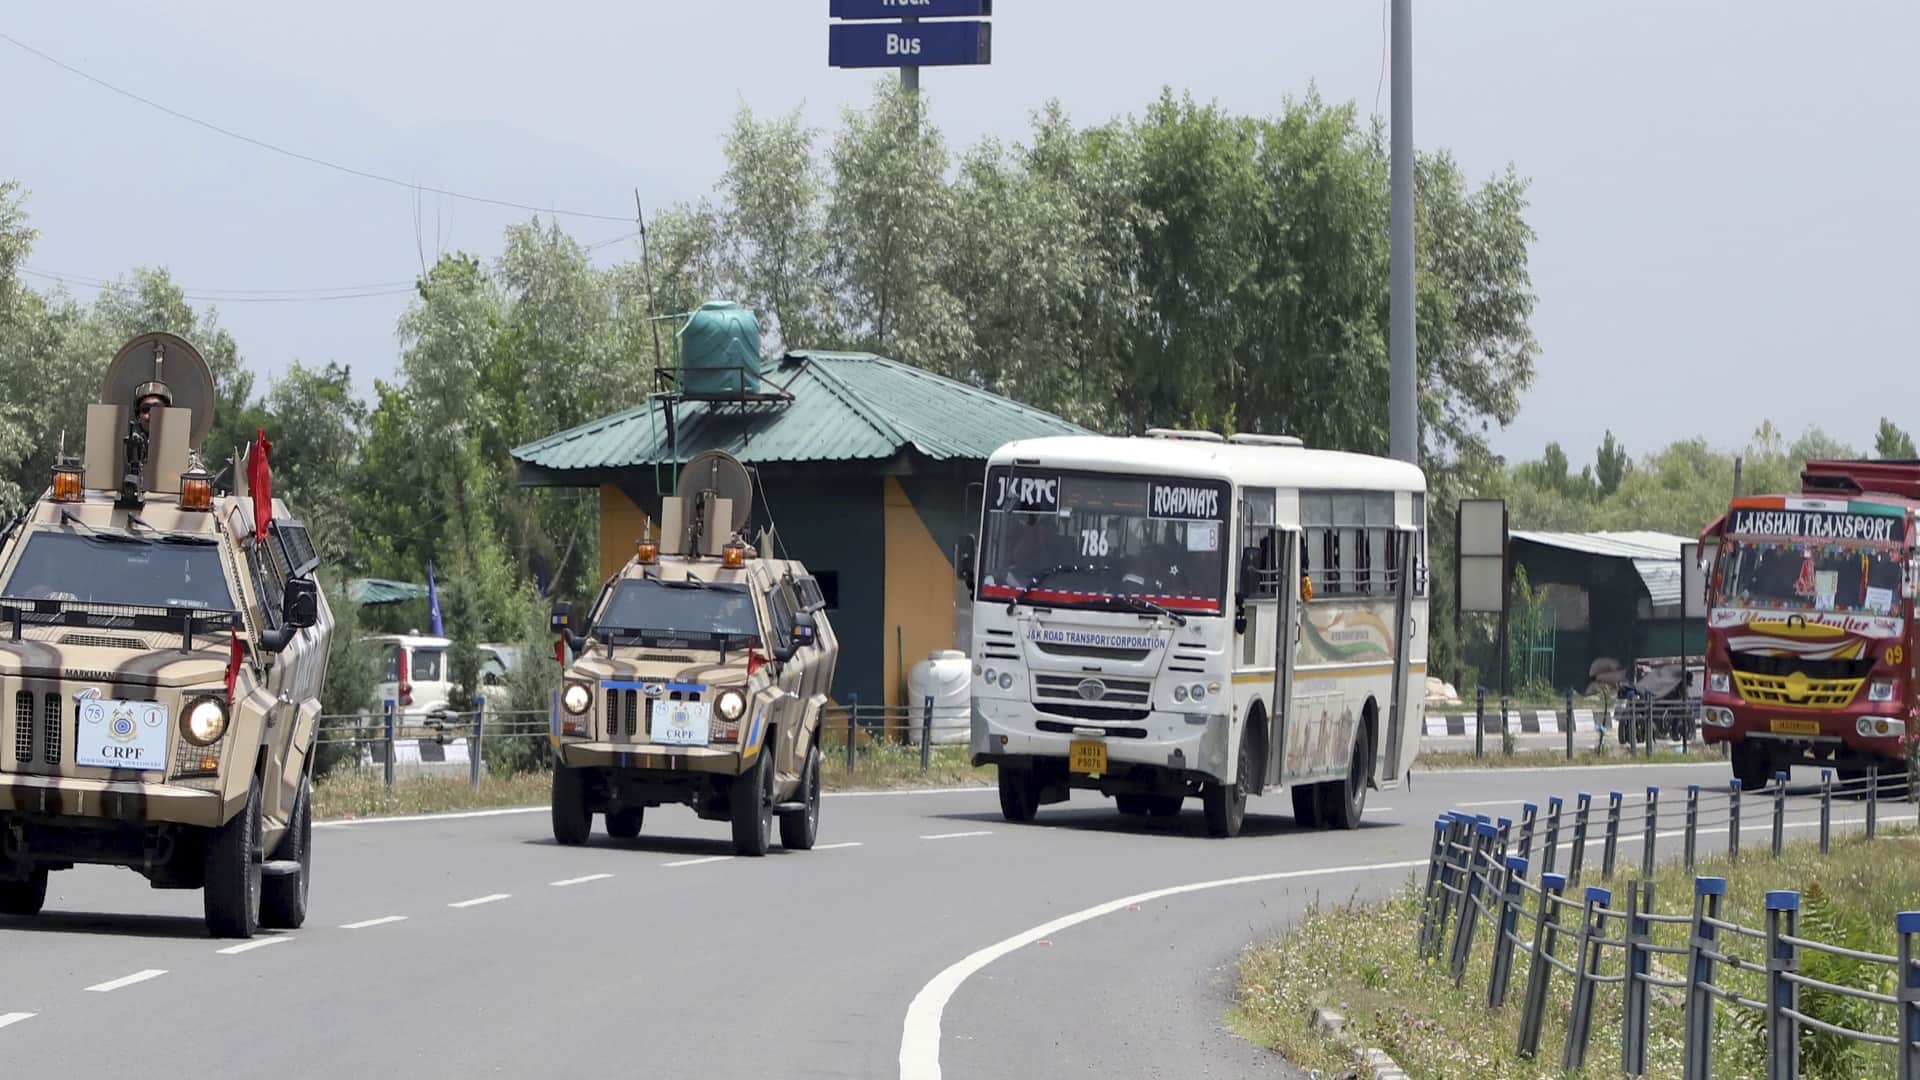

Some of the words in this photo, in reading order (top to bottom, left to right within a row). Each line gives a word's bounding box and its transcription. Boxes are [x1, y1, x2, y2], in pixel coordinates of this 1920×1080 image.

[886, 33, 921, 55] Bus
[1154, 486, 1218, 518] ROADWAYS
[1735, 511, 1800, 534] LAKSHMI
[1803, 513, 1895, 541] TRANSPORT
[1081, 529, 1109, 557] 786
[1026, 629, 1041, 640] J&K
[1043, 630, 1064, 640] ROAD
[87, 708, 101, 719] 75
[667, 729, 695, 739] CRPF
[102, 745, 144, 760] CRPF
